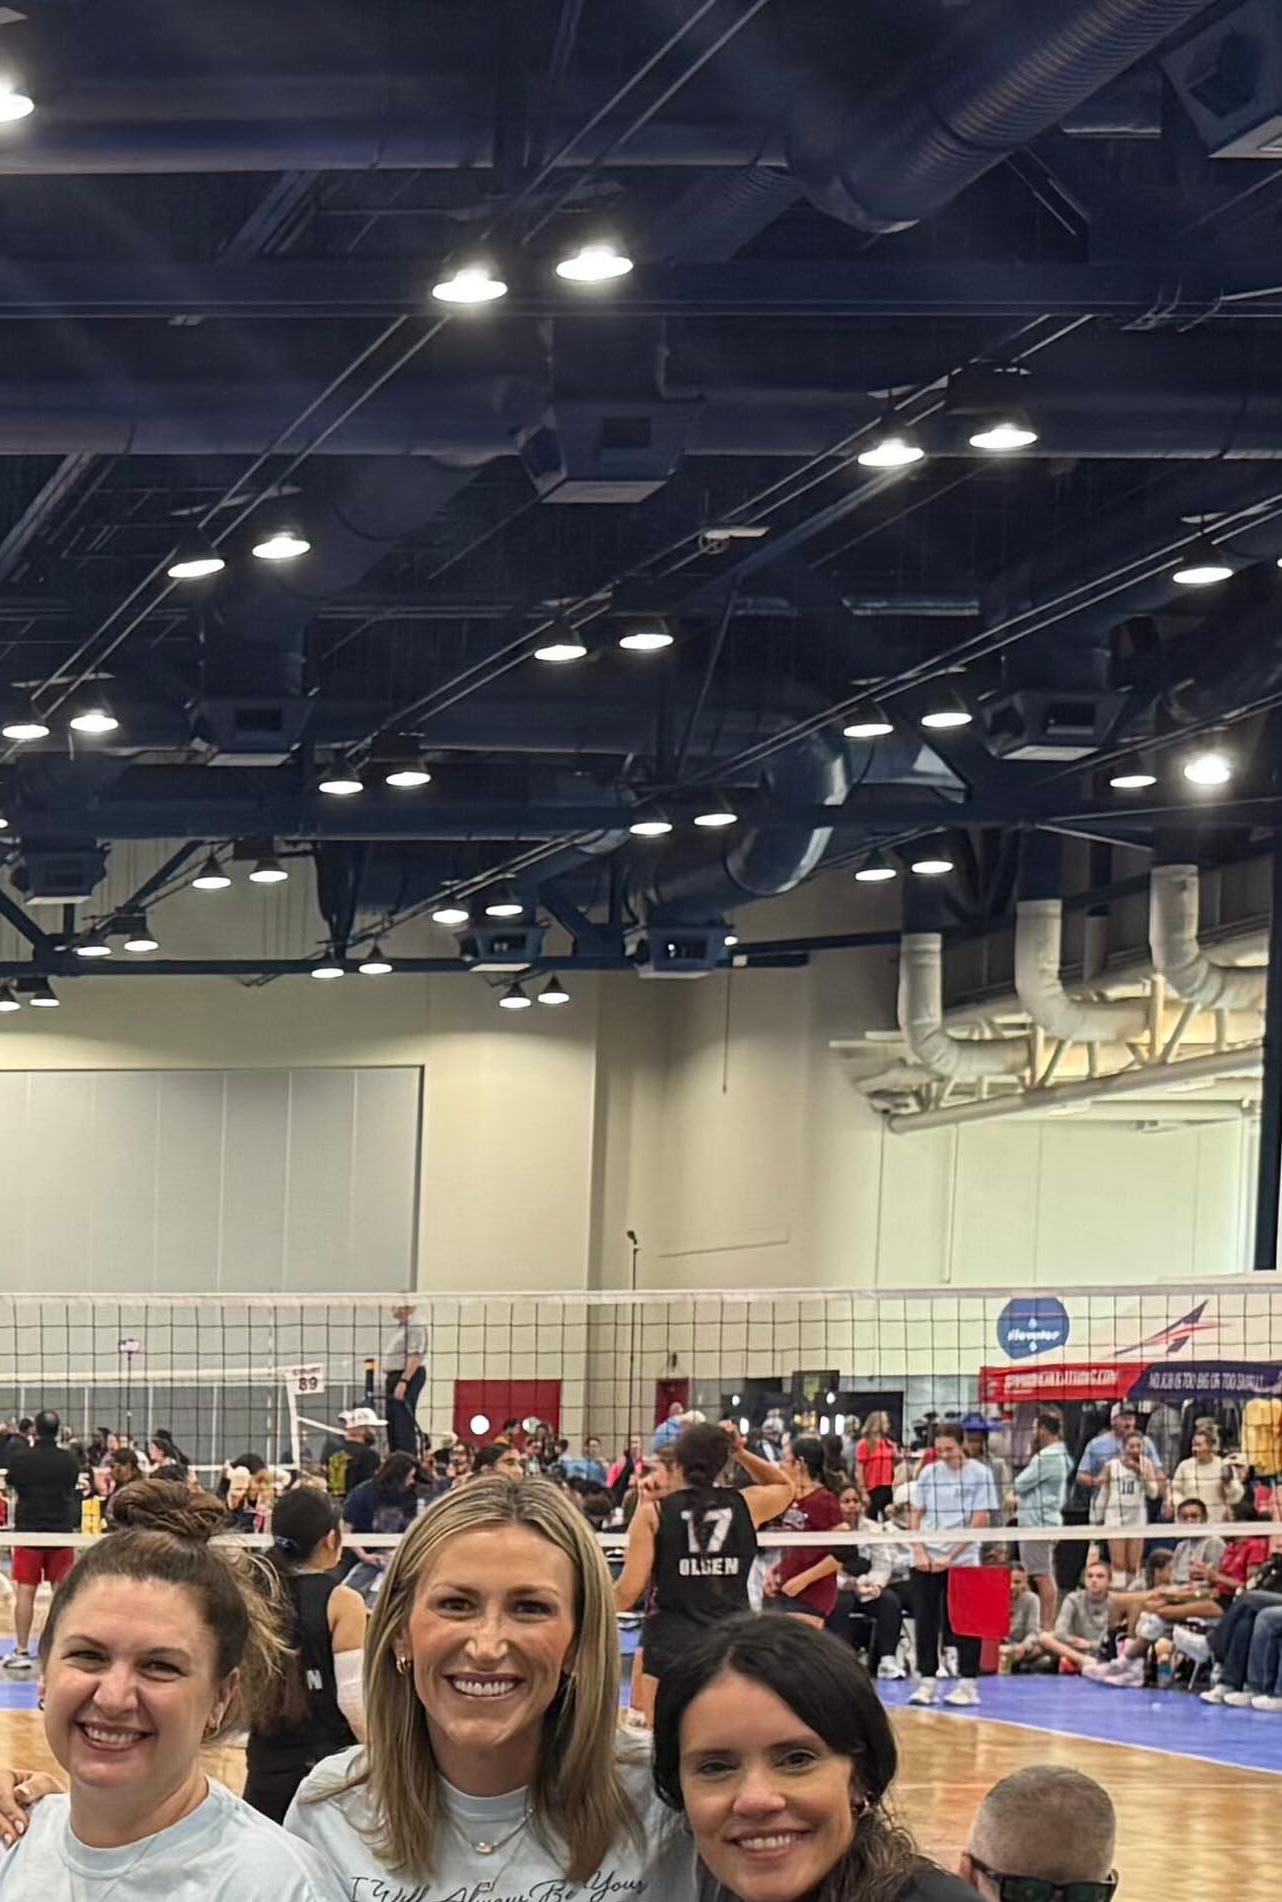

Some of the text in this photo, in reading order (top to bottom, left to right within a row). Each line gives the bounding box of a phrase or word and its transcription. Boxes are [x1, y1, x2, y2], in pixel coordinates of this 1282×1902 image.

[299, 1376, 318, 1391] 89
[680, 1507, 733, 1553] 17
[584, 1869, 647, 1902] Your
